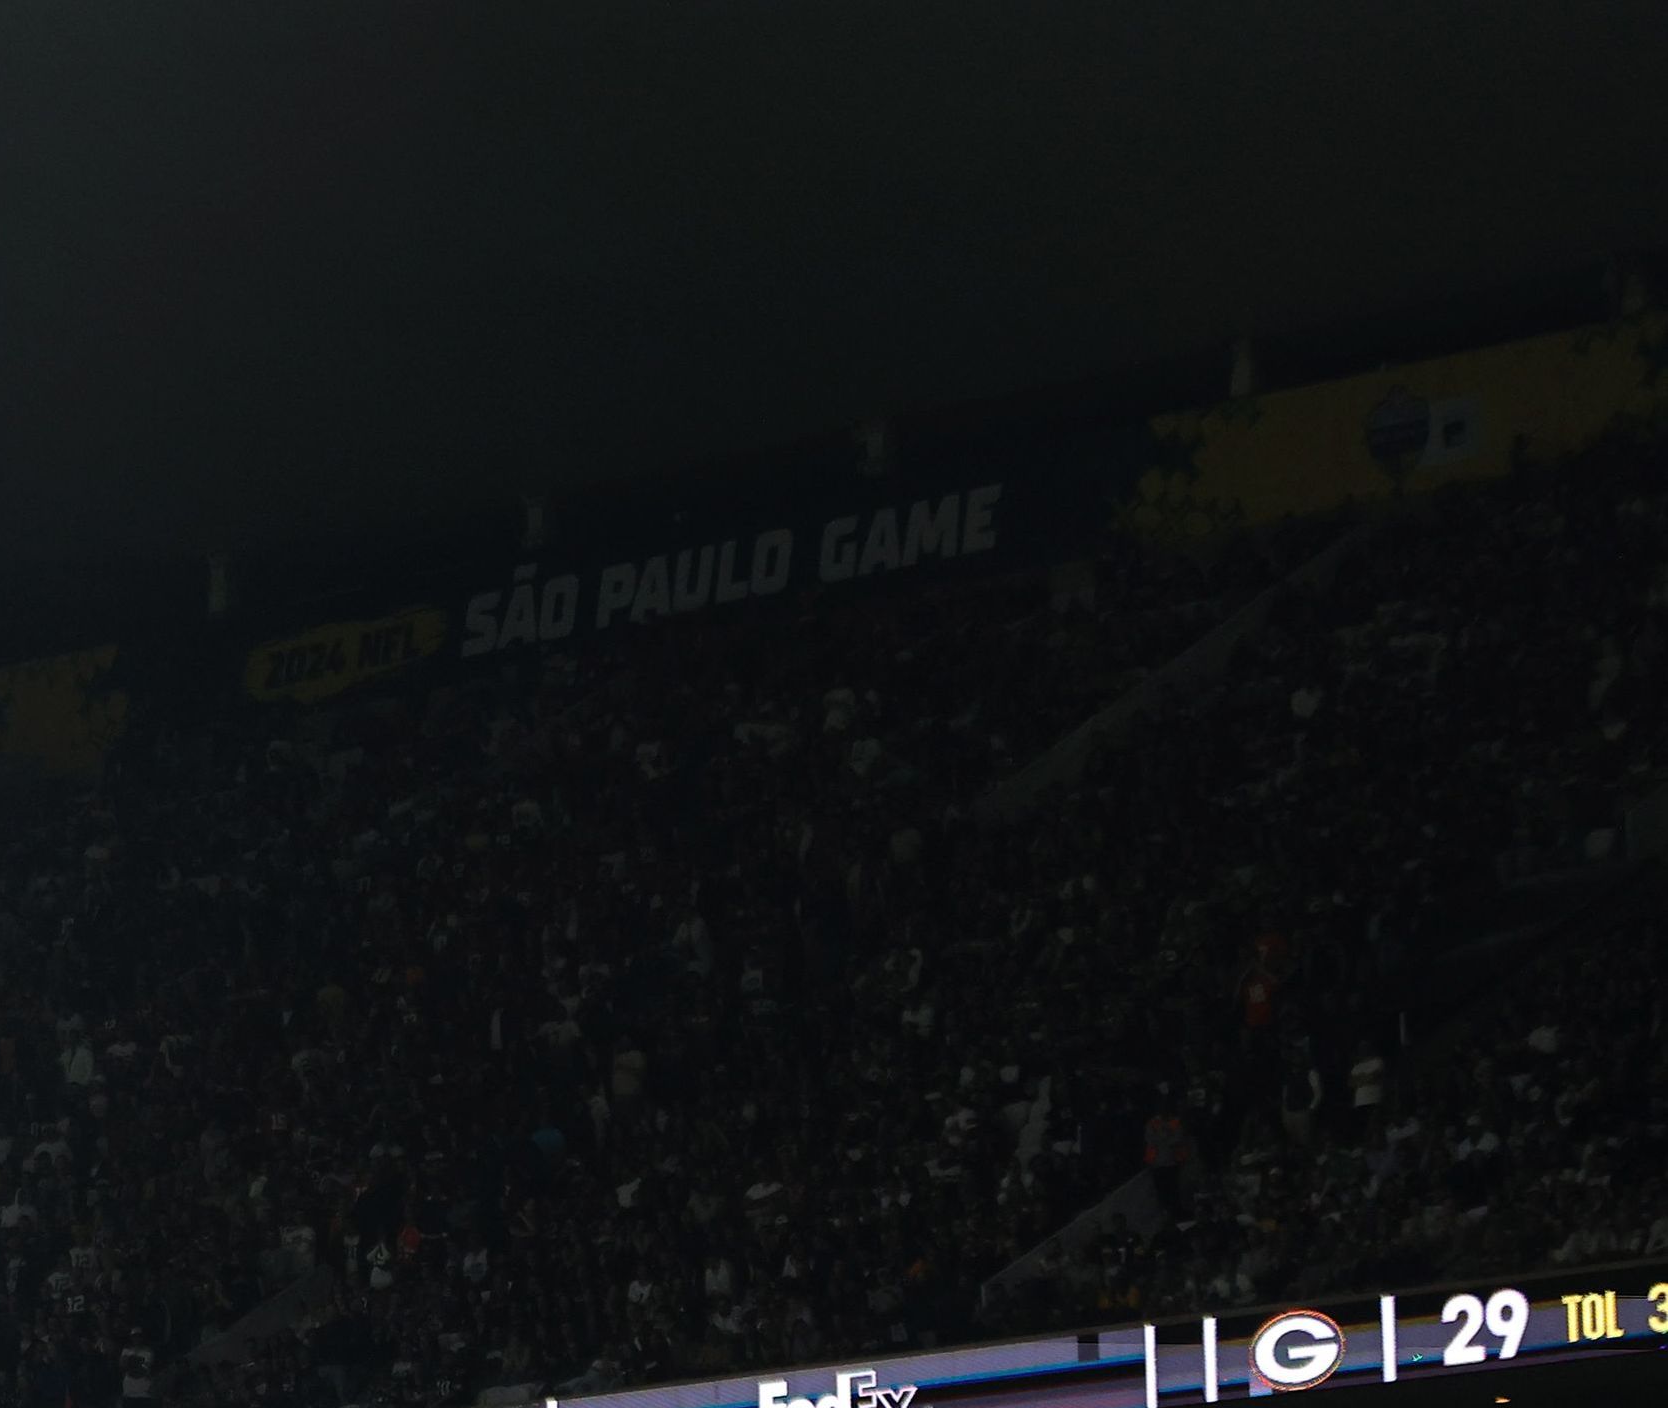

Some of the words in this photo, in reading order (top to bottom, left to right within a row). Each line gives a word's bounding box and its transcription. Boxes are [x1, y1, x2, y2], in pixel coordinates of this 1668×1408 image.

[269, 639, 347, 688] 2024
[360, 620, 419, 671] NFL
[462, 563, 580, 659] SÃO
[595, 528, 794, 628] PAULO
[819, 484, 1002, 584] GAME
[1440, 1289, 1531, 1367] 29
[1561, 1290, 1625, 1343] TOL
